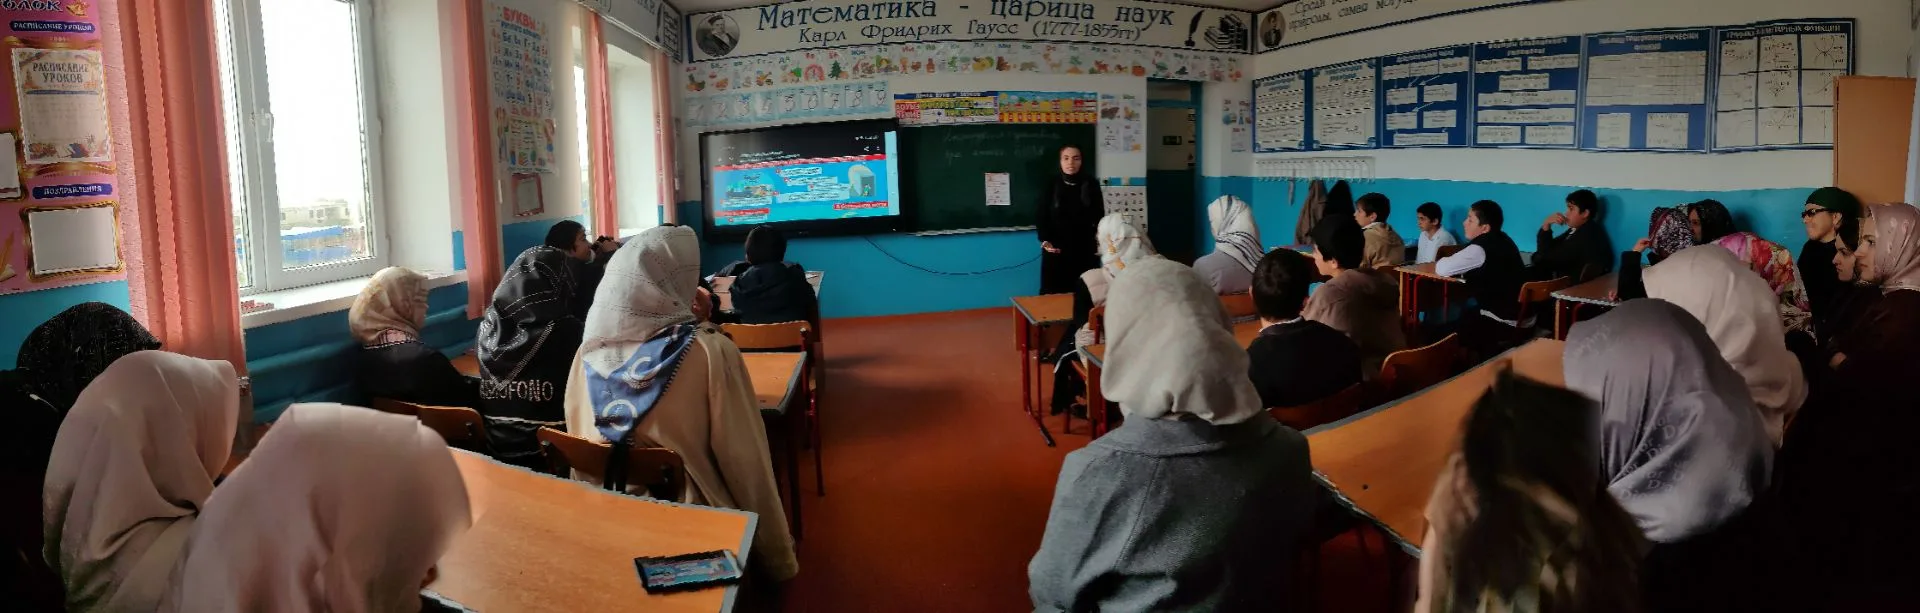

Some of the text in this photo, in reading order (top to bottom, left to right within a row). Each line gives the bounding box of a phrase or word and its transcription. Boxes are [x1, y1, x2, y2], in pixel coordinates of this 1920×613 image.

[13, 22, 62, 31] РАСПИСАНИЕ
[503, 6, 536, 31] БУКВЫ
[758, 0, 938, 30] Математика
[990, 0, 1095, 21] царица
[1115, 6, 1175, 31] наук
[798, 20, 1141, 46] Карл Фридрих Гаусс (1777-1855гг)
[33, 62, 89, 82] РАСПИСАНИЕ УРОКОВ
